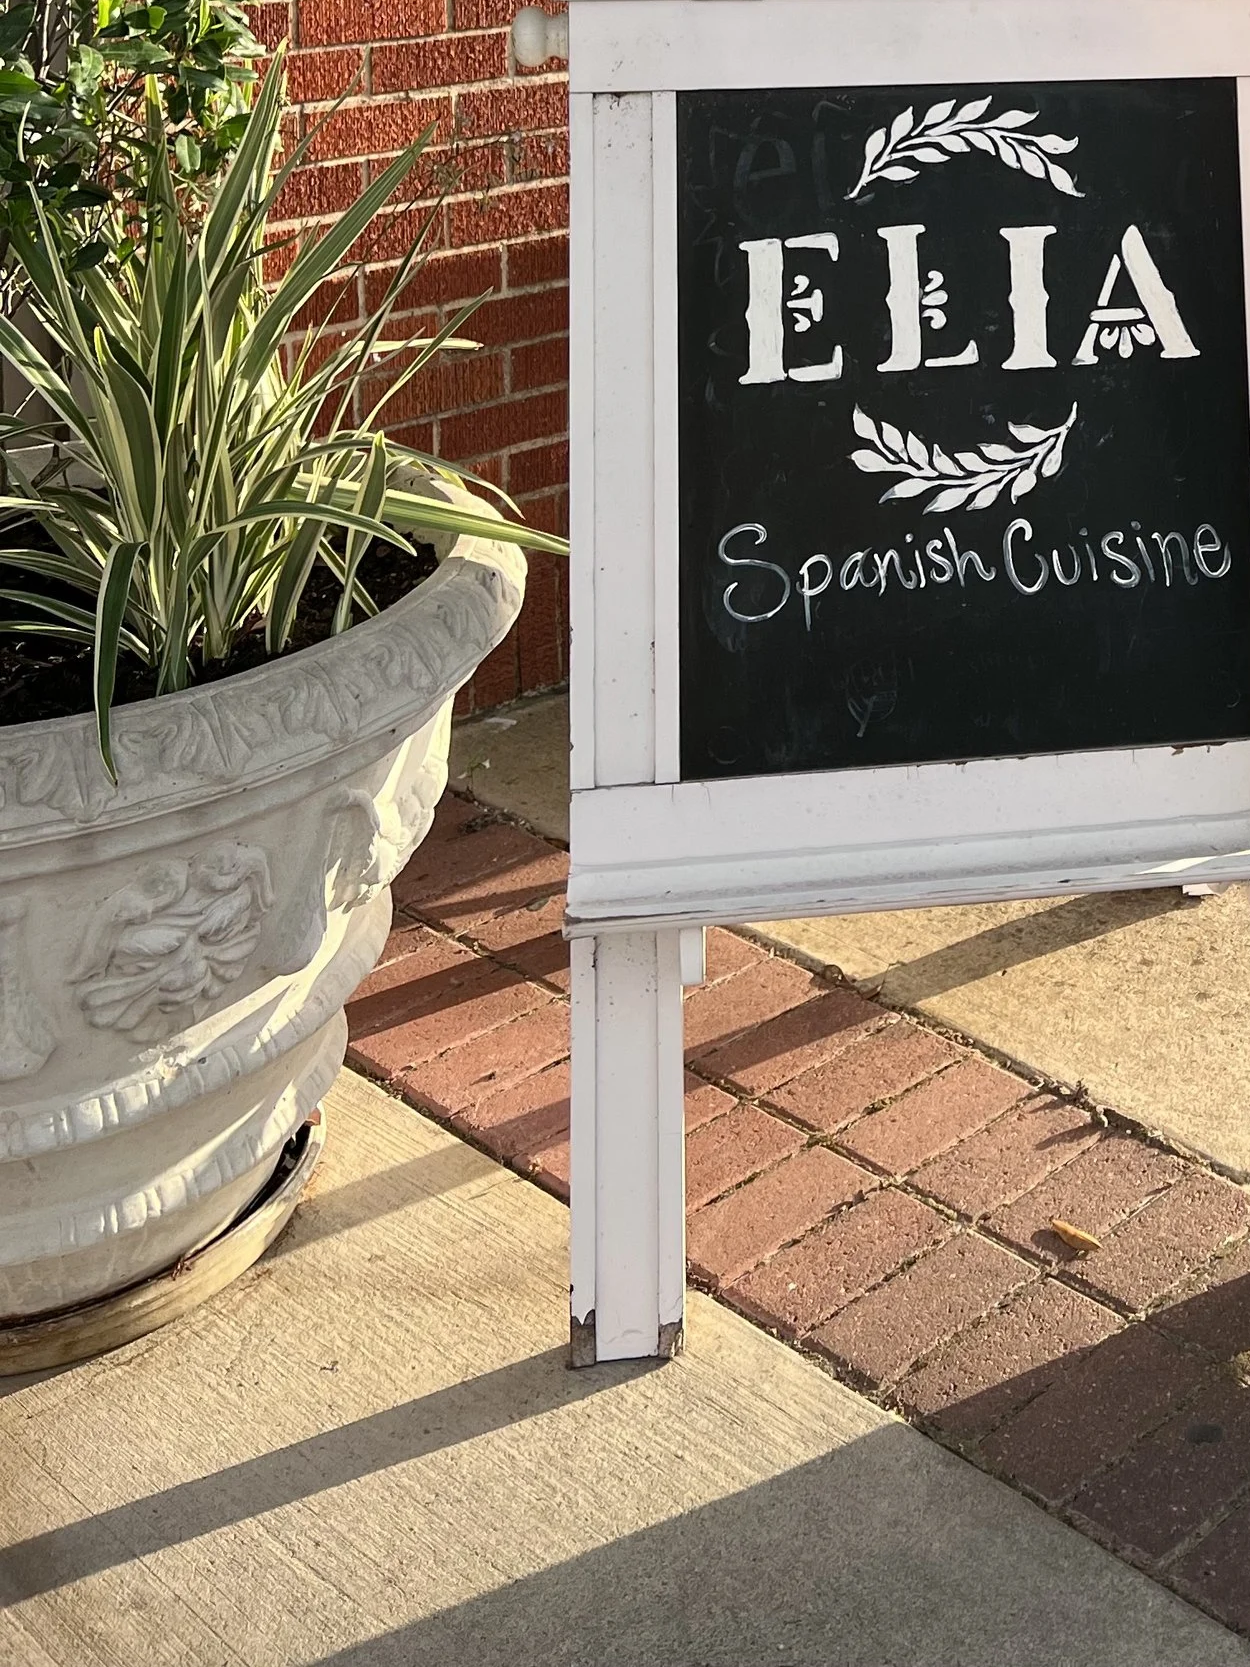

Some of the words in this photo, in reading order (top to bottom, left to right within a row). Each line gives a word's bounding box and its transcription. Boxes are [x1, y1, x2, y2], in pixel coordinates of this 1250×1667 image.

[738, 223, 1201, 385] ELIA
[718, 522, 996, 631] Spanish
[1002, 517, 1232, 594] Cuisine
